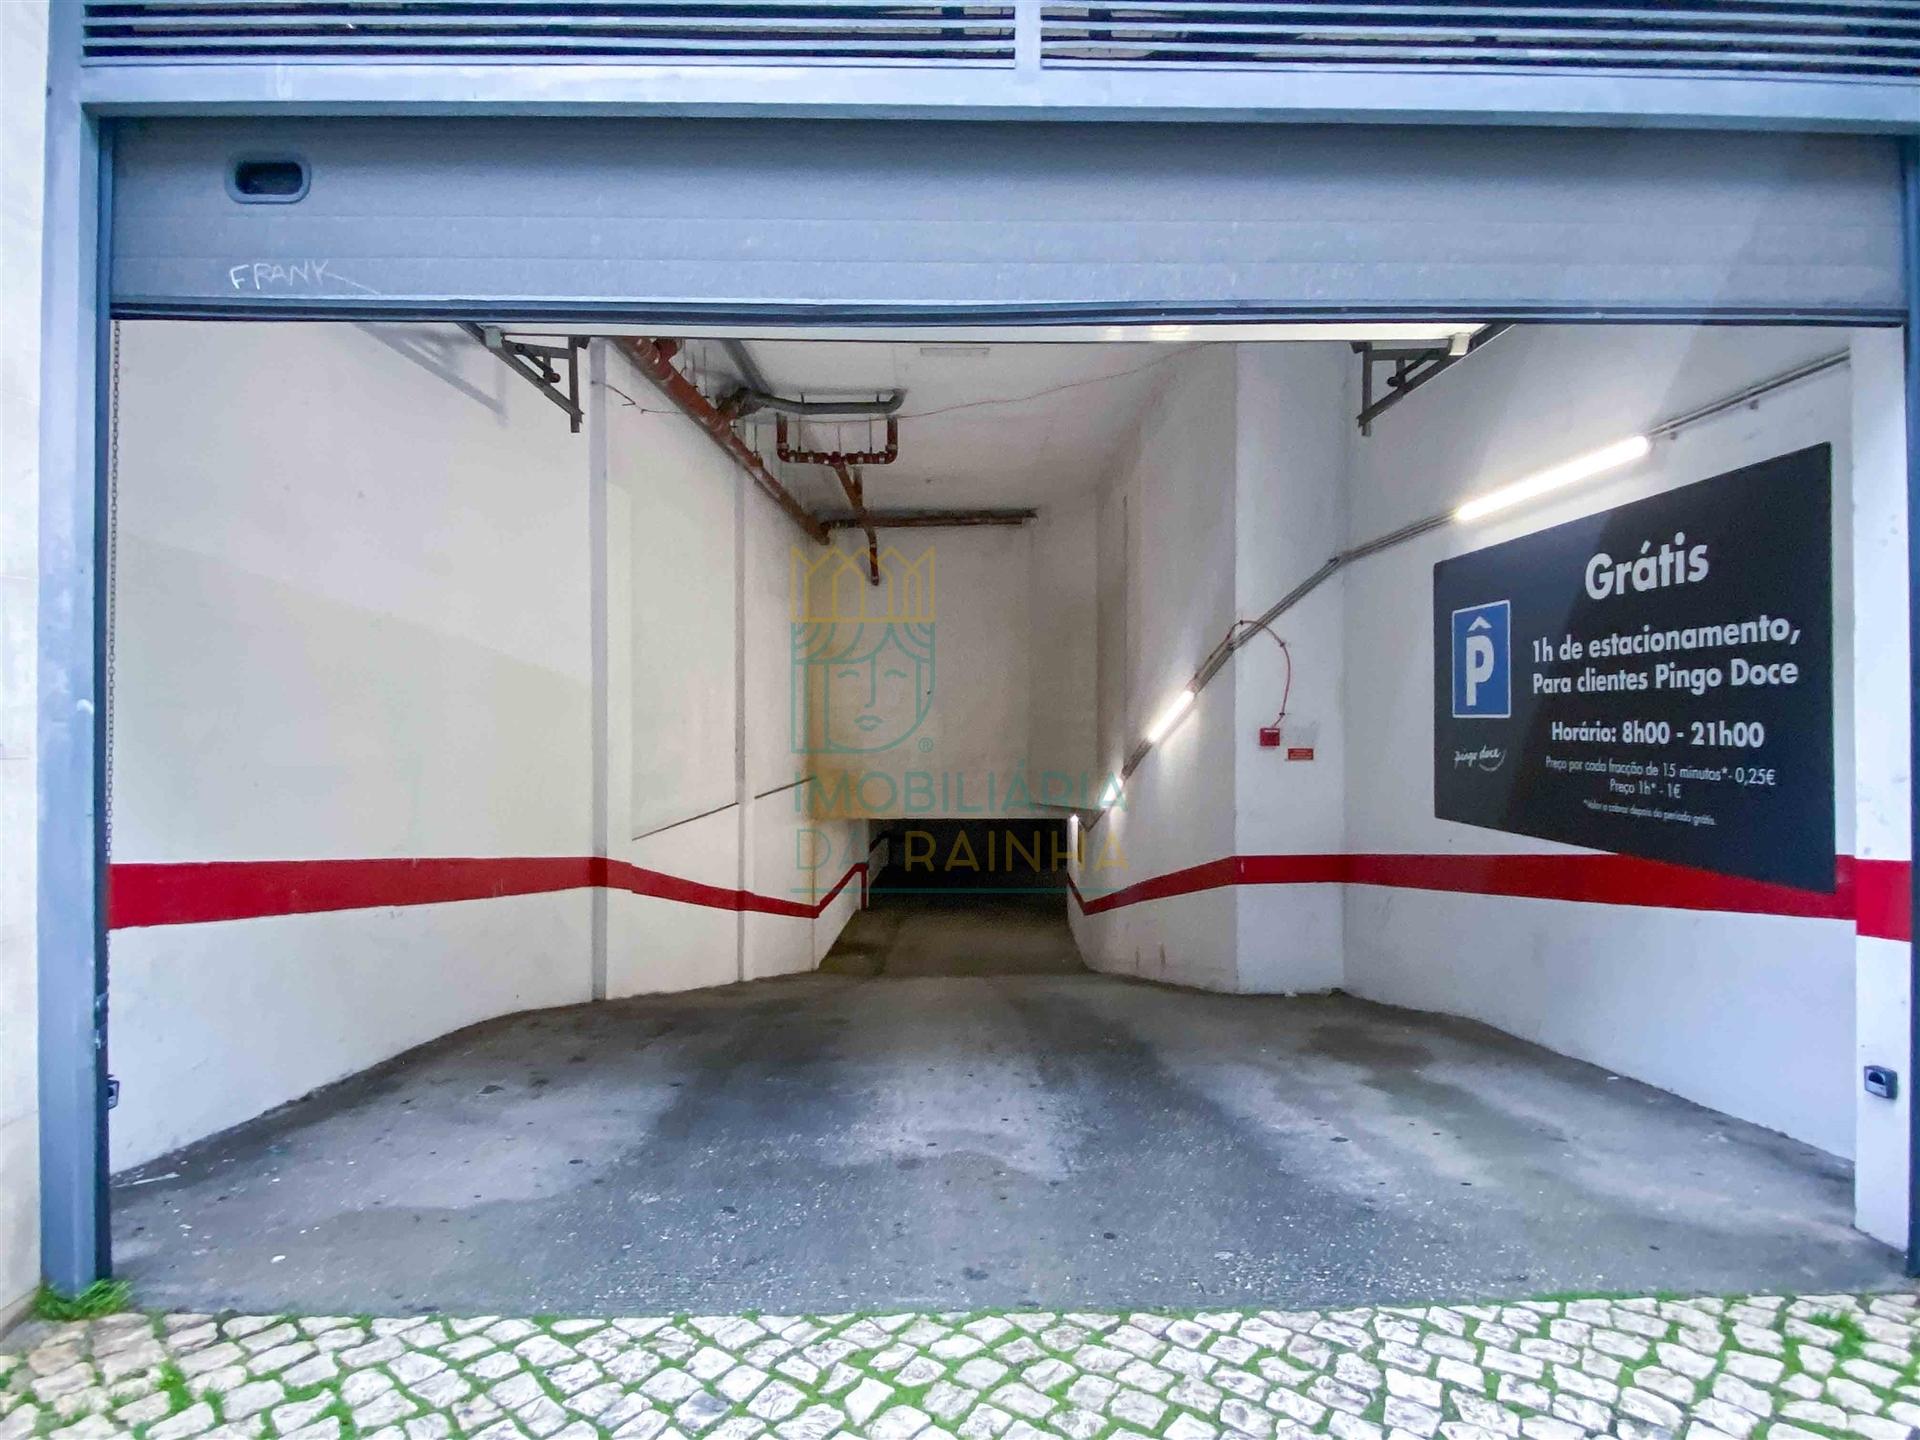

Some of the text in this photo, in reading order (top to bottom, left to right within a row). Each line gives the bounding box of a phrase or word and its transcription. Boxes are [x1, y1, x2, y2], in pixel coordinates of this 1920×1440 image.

[229, 258, 379, 295] FRANK
[1585, 531, 1709, 600] Grátis
[1532, 614, 1801, 663] 1h de estacionamento,
[1532, 657, 1799, 696] Para clientes Pingo Doce
[1551, 720, 1617, 743] Horário:
[1621, 719, 1671, 745] 8h00
[1690, 719, 1765, 749] 21h00
[1545, 755, 1567, 771] Preço
[1568, 759, 1583, 773] por
[1584, 757, 1607, 772] cada
[1645, 760, 1659, 776] de
[1663, 762, 1677, 778] 15
[1734, 766, 1777, 786] 0,25€
[1609, 778, 1636, 796] Preço
[1667, 782, 1682, 799] 1€
